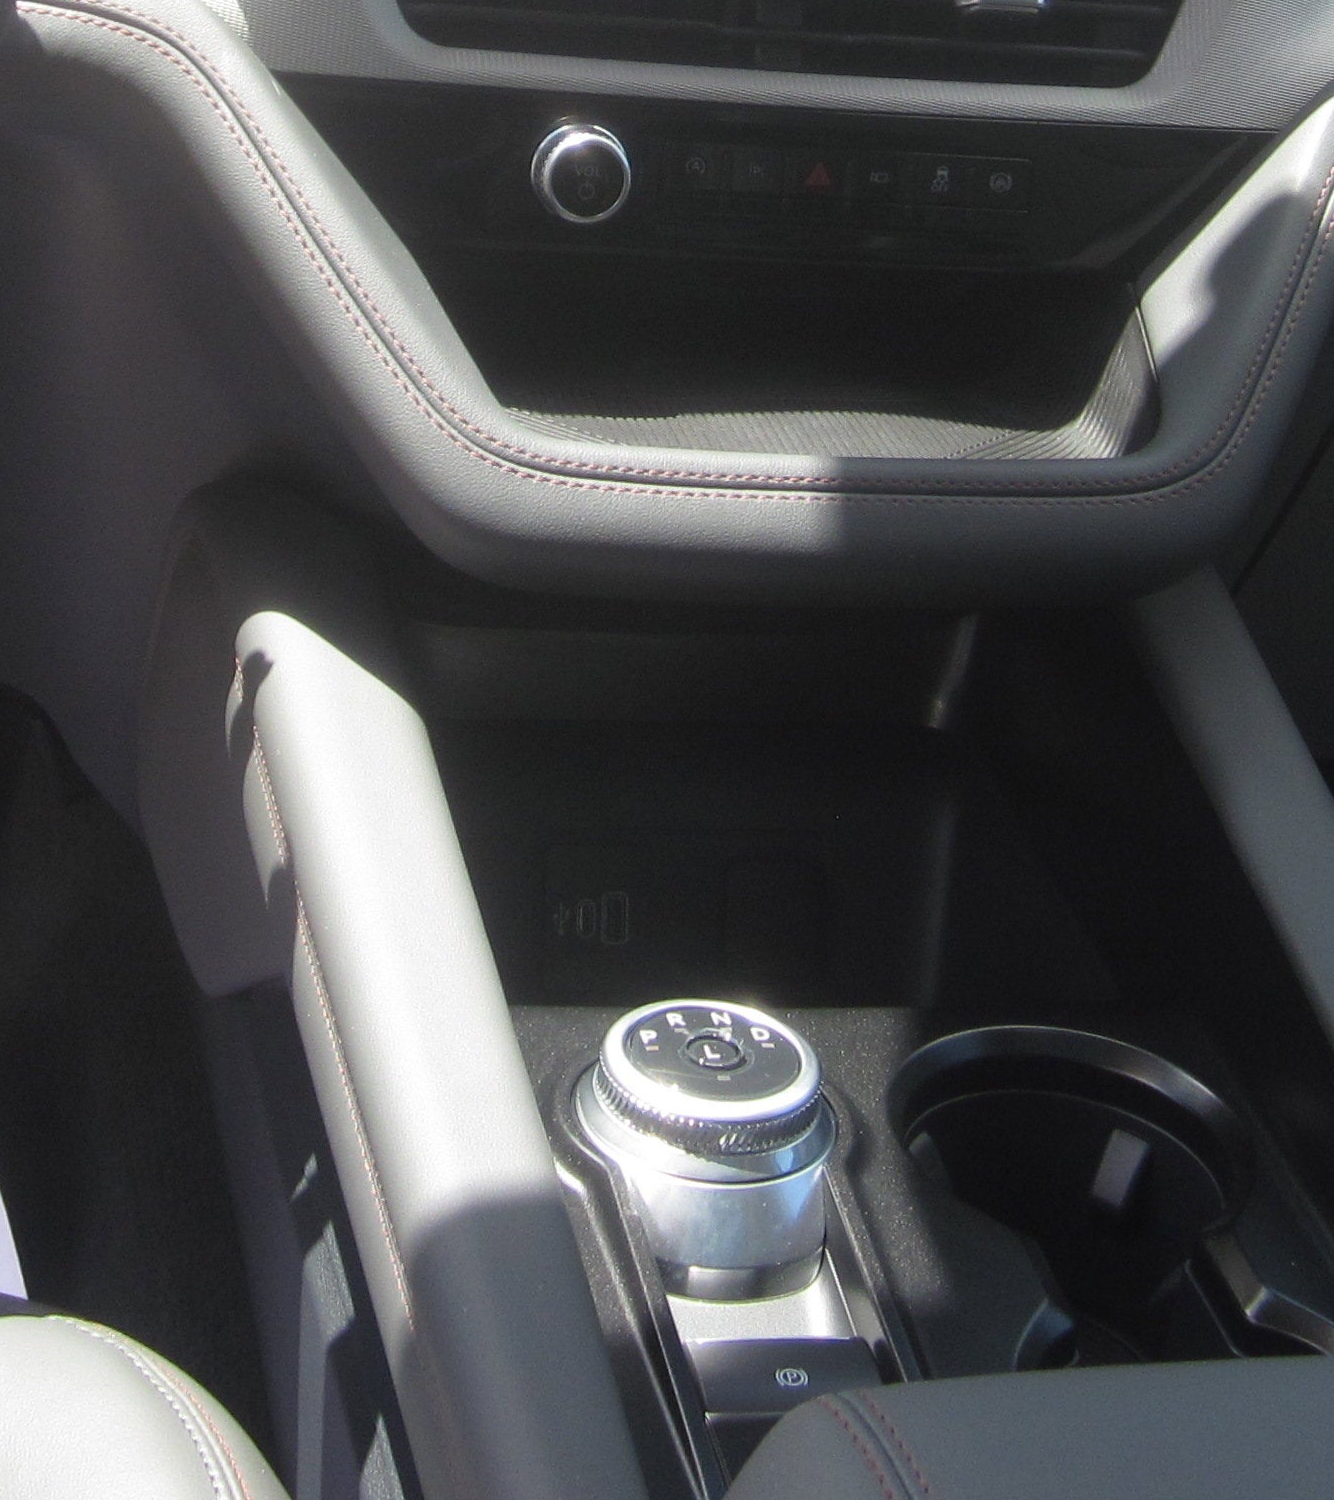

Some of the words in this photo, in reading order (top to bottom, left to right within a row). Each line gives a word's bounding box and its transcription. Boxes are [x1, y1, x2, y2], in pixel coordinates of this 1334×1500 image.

[665, 1011, 687, 1027] R
[710, 1011, 732, 1026] N
[639, 1029, 658, 1045] P
[749, 1026, 771, 1042] D
[702, 1043, 721, 1060] L
